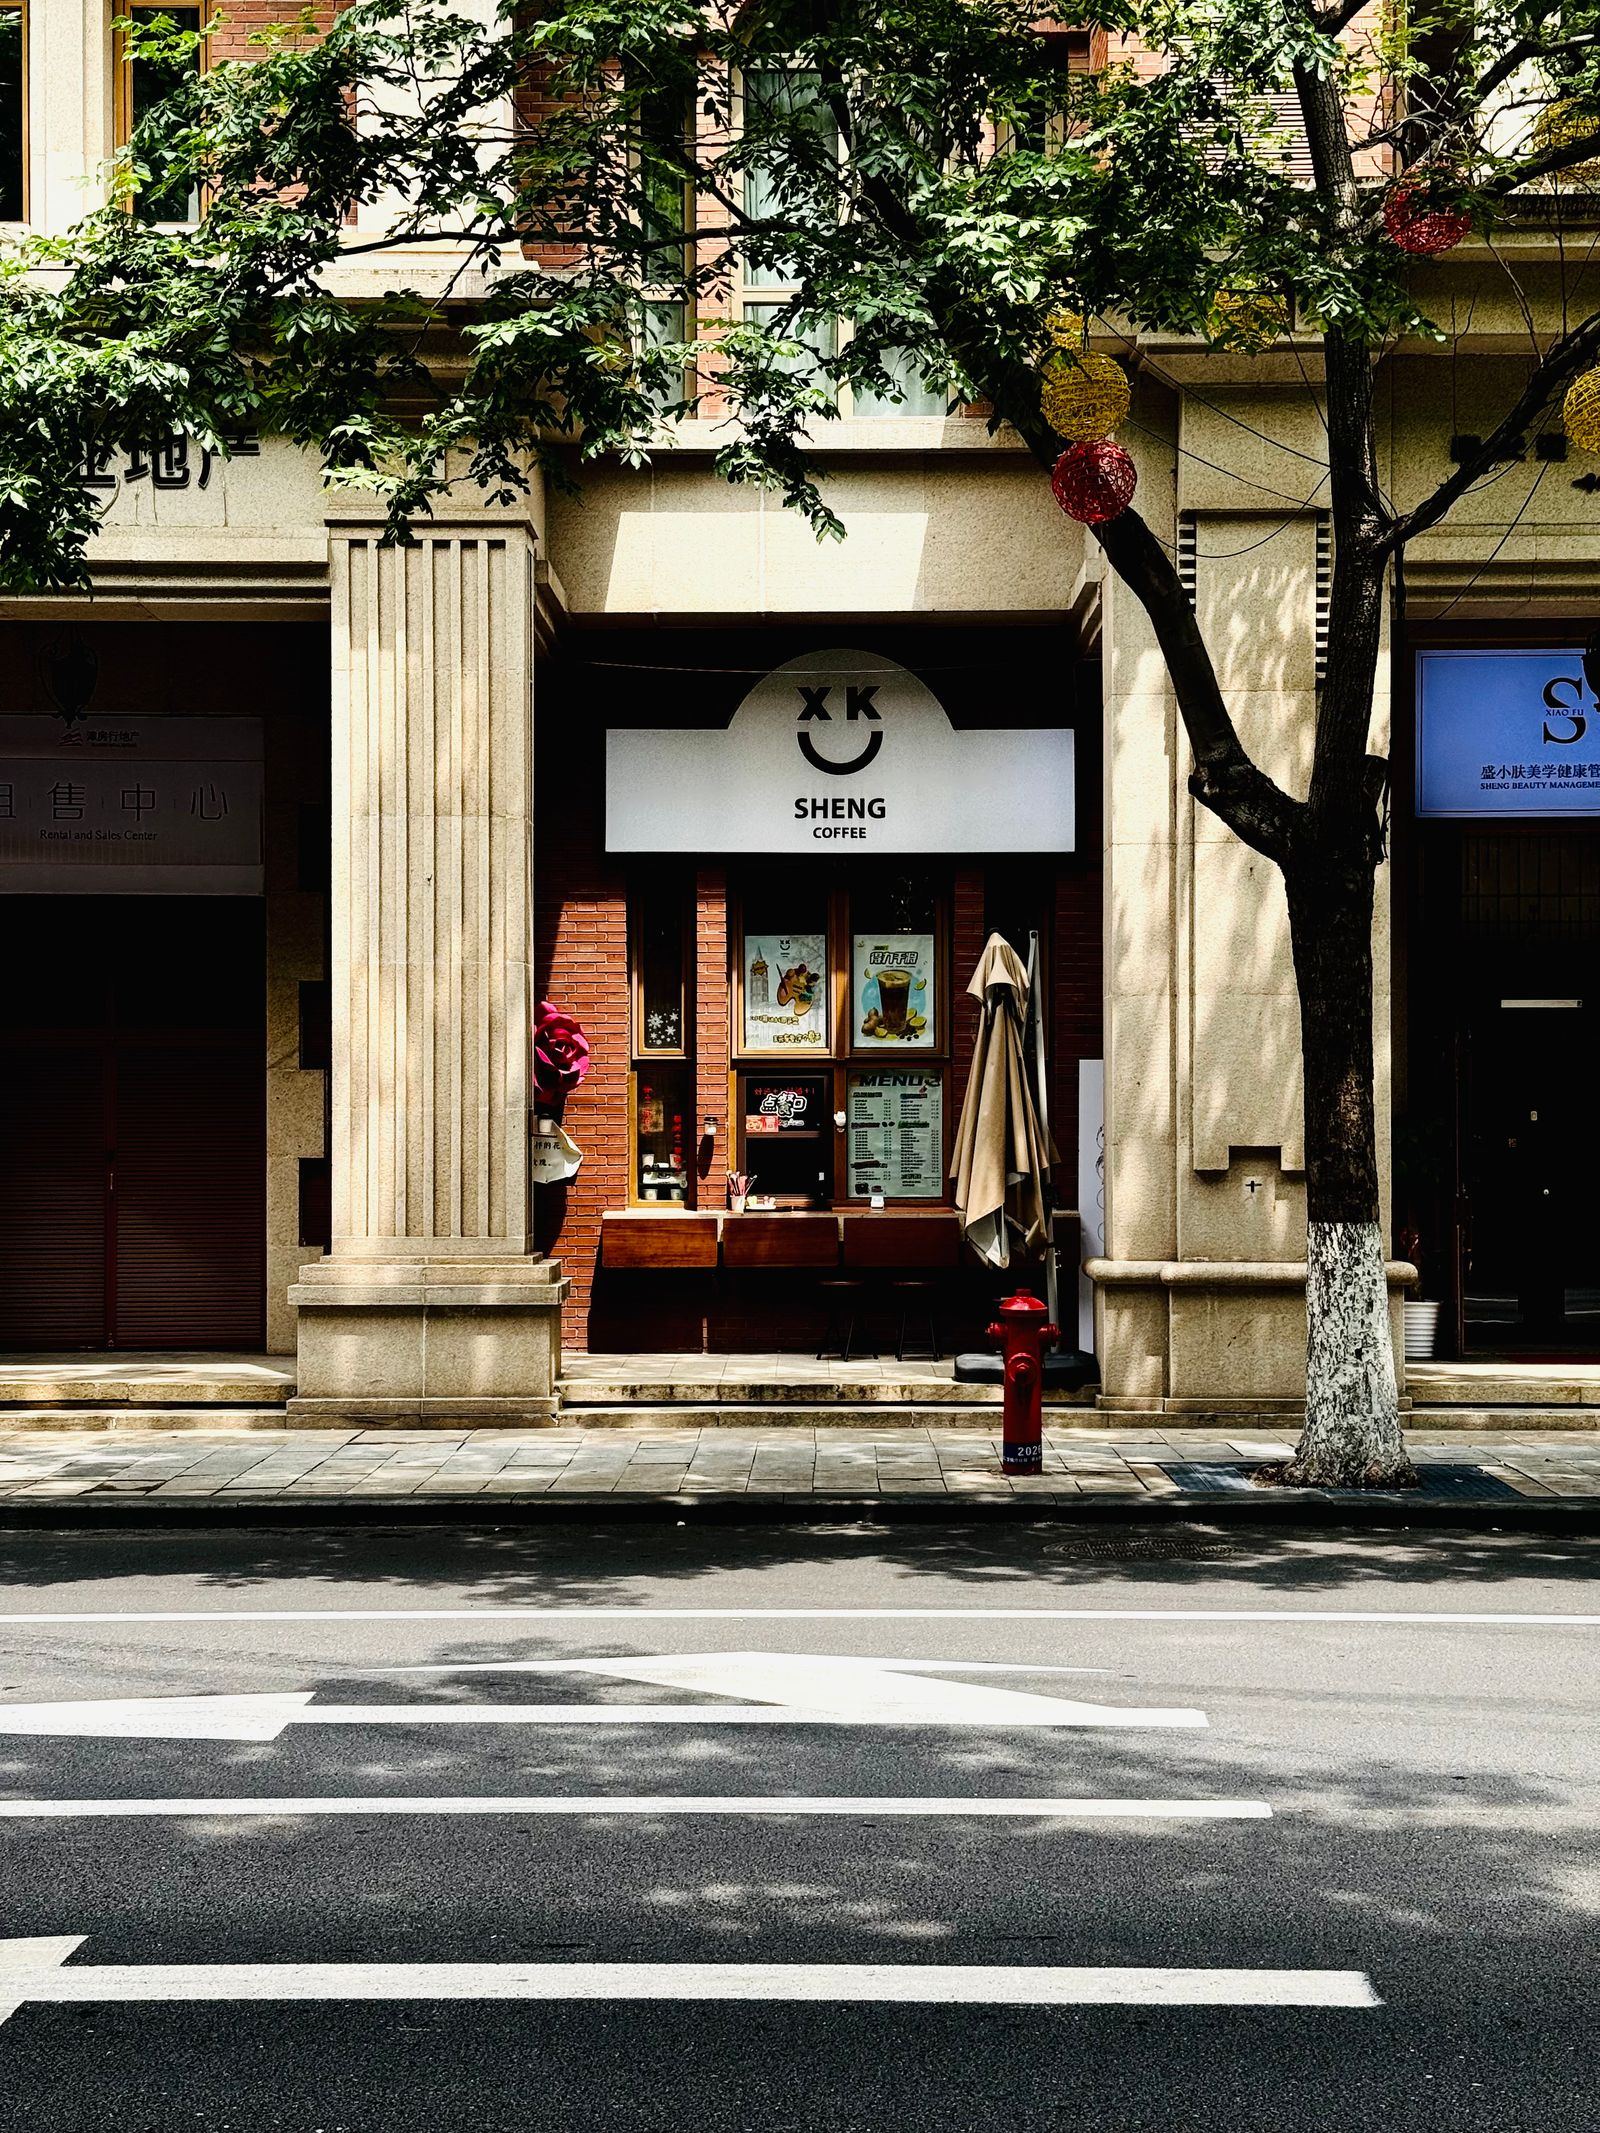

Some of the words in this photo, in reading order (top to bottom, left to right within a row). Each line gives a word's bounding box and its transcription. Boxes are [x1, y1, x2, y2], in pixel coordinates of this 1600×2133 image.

[1545, 708, 1569, 717] XIAO
[1572, 708, 1584, 716] FU
[1481, 764, 1600, 780] 盛小肤美学健康管
[1480, 781, 1510, 790] SHENG
[1512, 781, 1547, 789] BEAUTY
[794, 797, 886, 820] SHENG
[39, 829, 72, 841] Rental
[74, 829, 93, 841] and
[95, 830, 122, 841] Sales
[124, 830, 158, 841] Center
[812, 827, 867, 839] COFFEE
[859, 1075, 921, 1087] MENU
[760, 1091, 807, 1118] 点餐口
